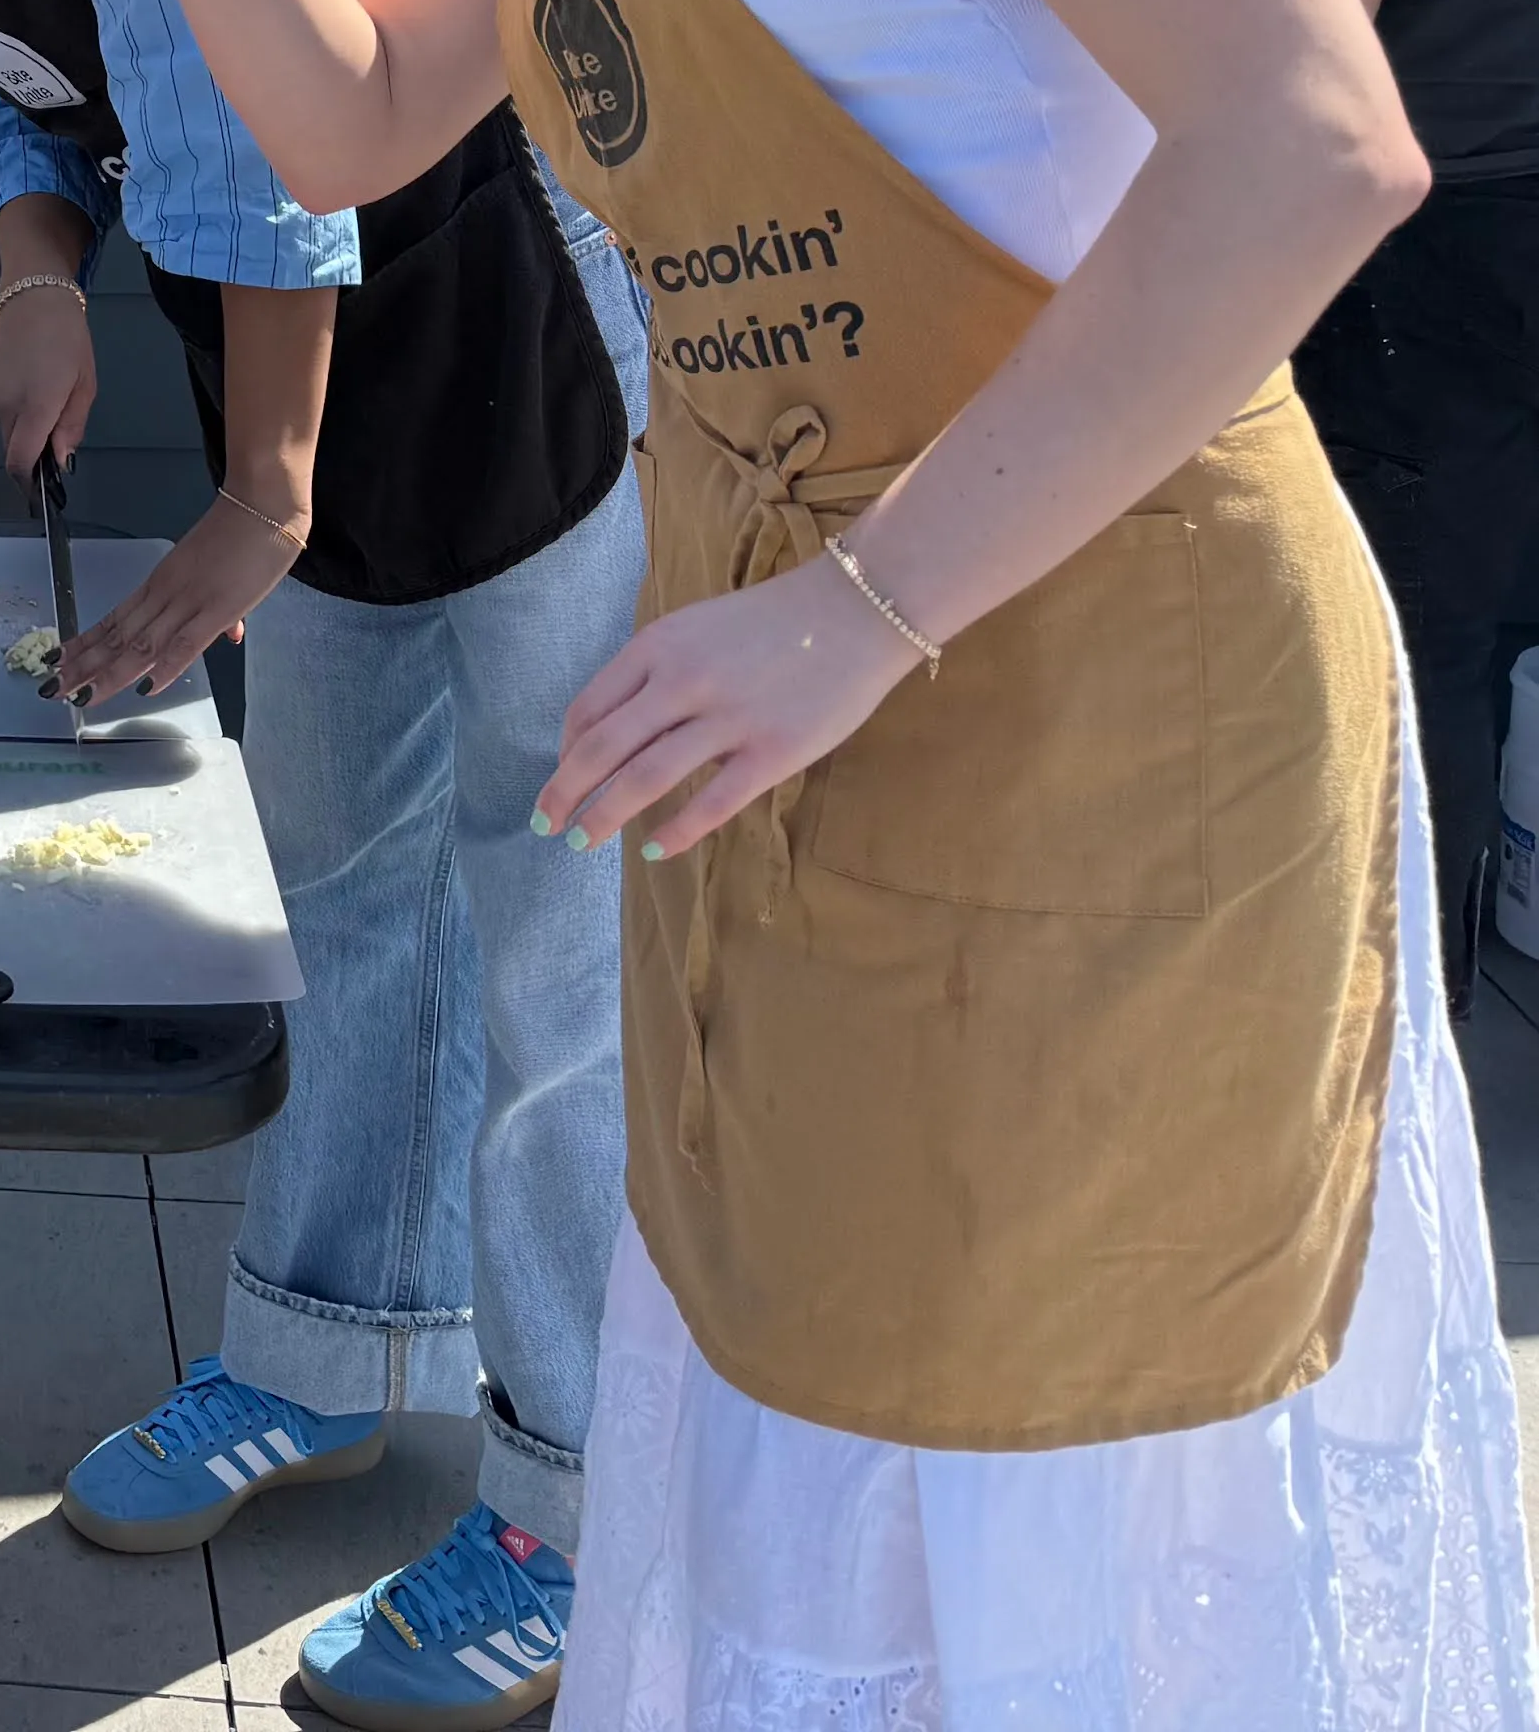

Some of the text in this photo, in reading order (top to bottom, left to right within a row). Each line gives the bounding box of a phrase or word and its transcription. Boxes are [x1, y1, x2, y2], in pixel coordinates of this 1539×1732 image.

[1, 70, 33, 85] Bite
[14, 87, 54, 105] Unite
[651, 209, 843, 293] cookin'
[671, 301, 864, 374] ookin'?
